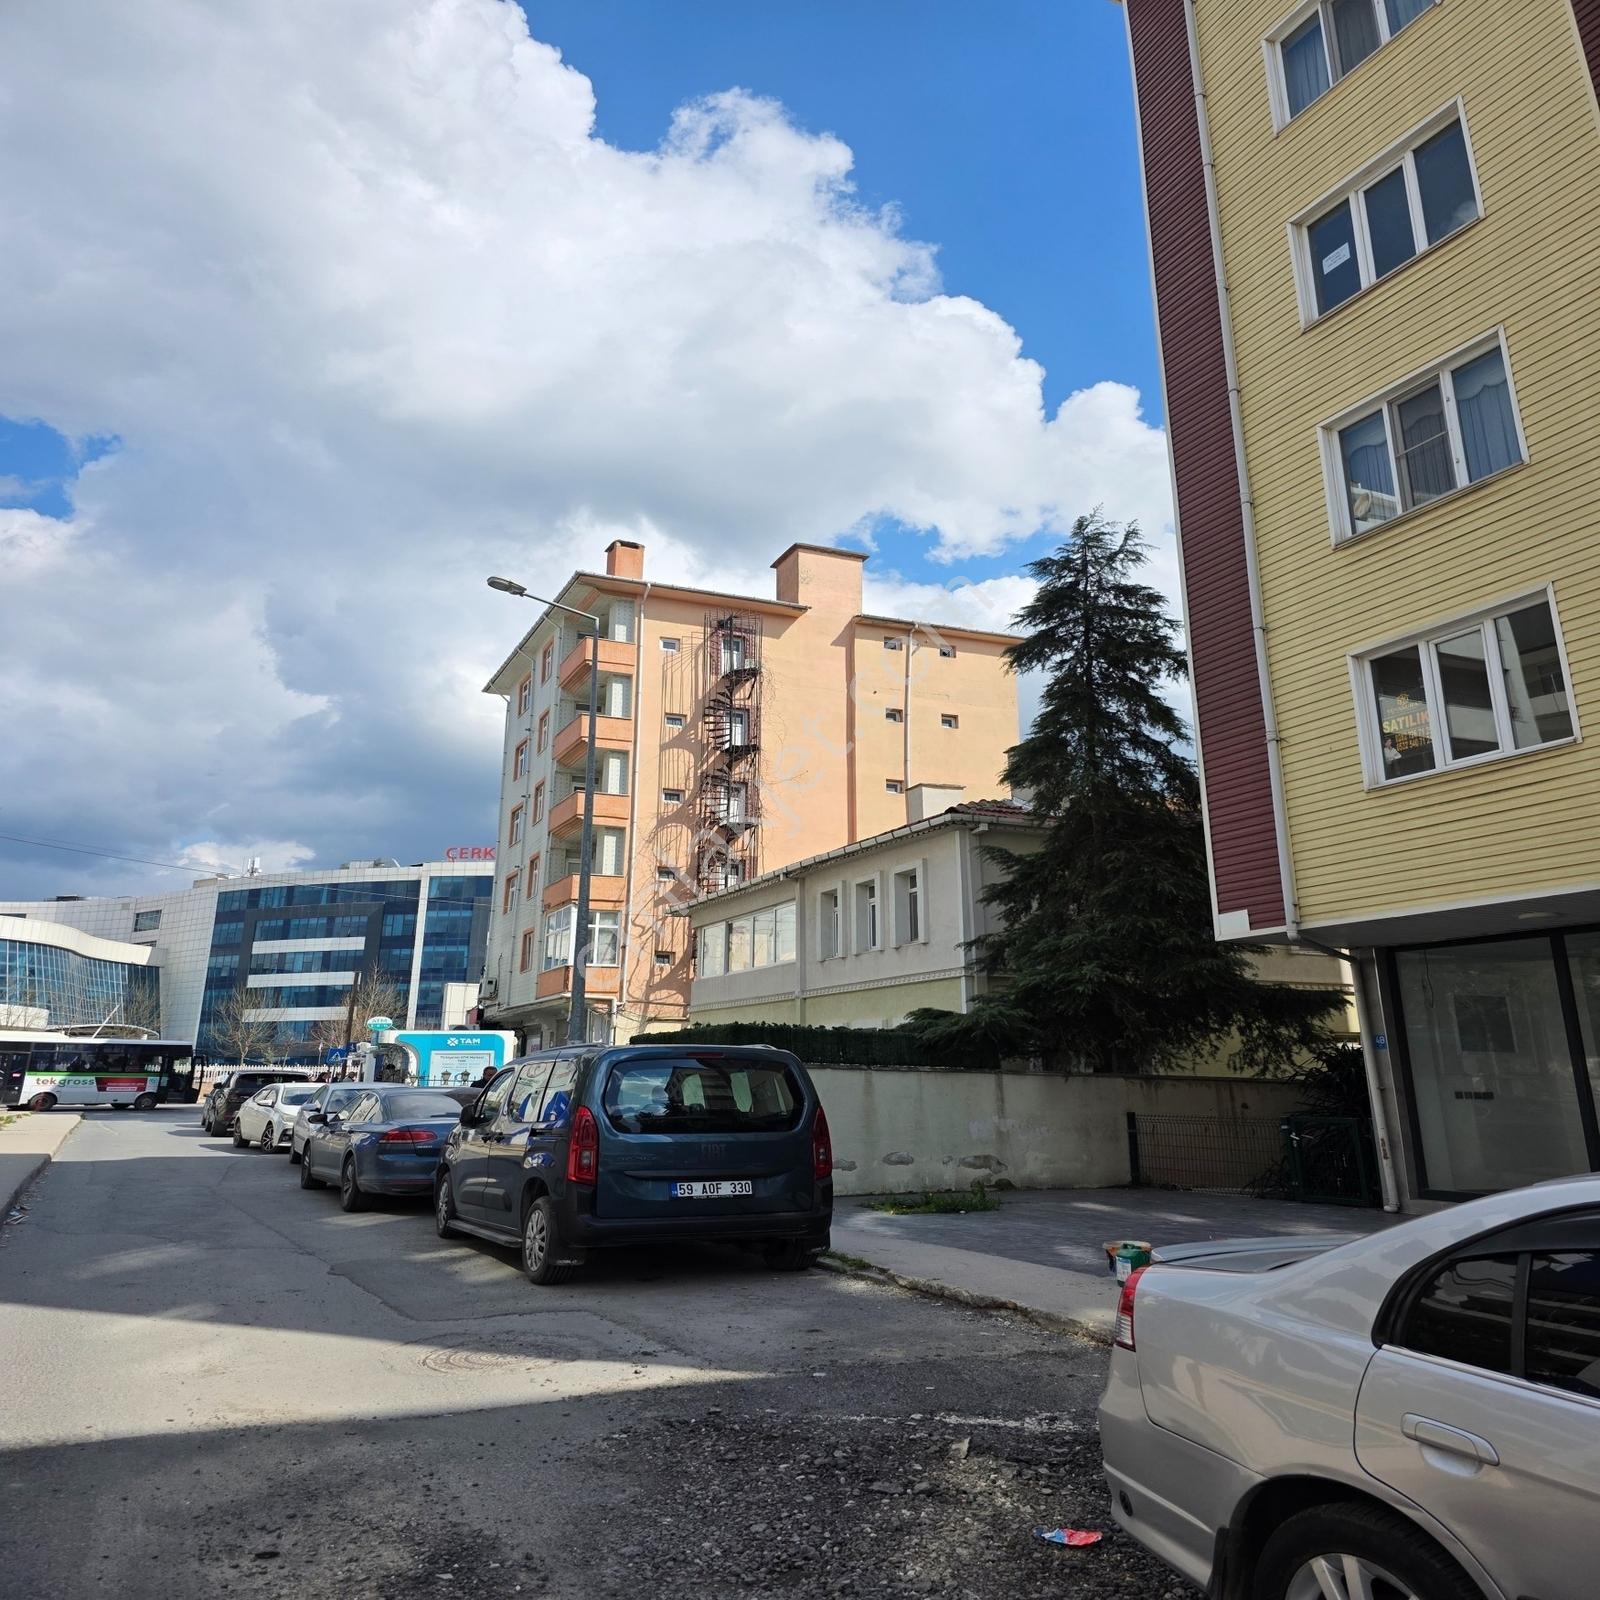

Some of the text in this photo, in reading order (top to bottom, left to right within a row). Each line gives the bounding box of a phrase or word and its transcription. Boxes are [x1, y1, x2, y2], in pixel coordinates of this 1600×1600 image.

[1382, 711, 1429, 733] SATILIK
[679, 1184, 693, 1195] 59
[702, 1183, 722, 1195] AOF
[730, 1182, 751, 1194] 330
